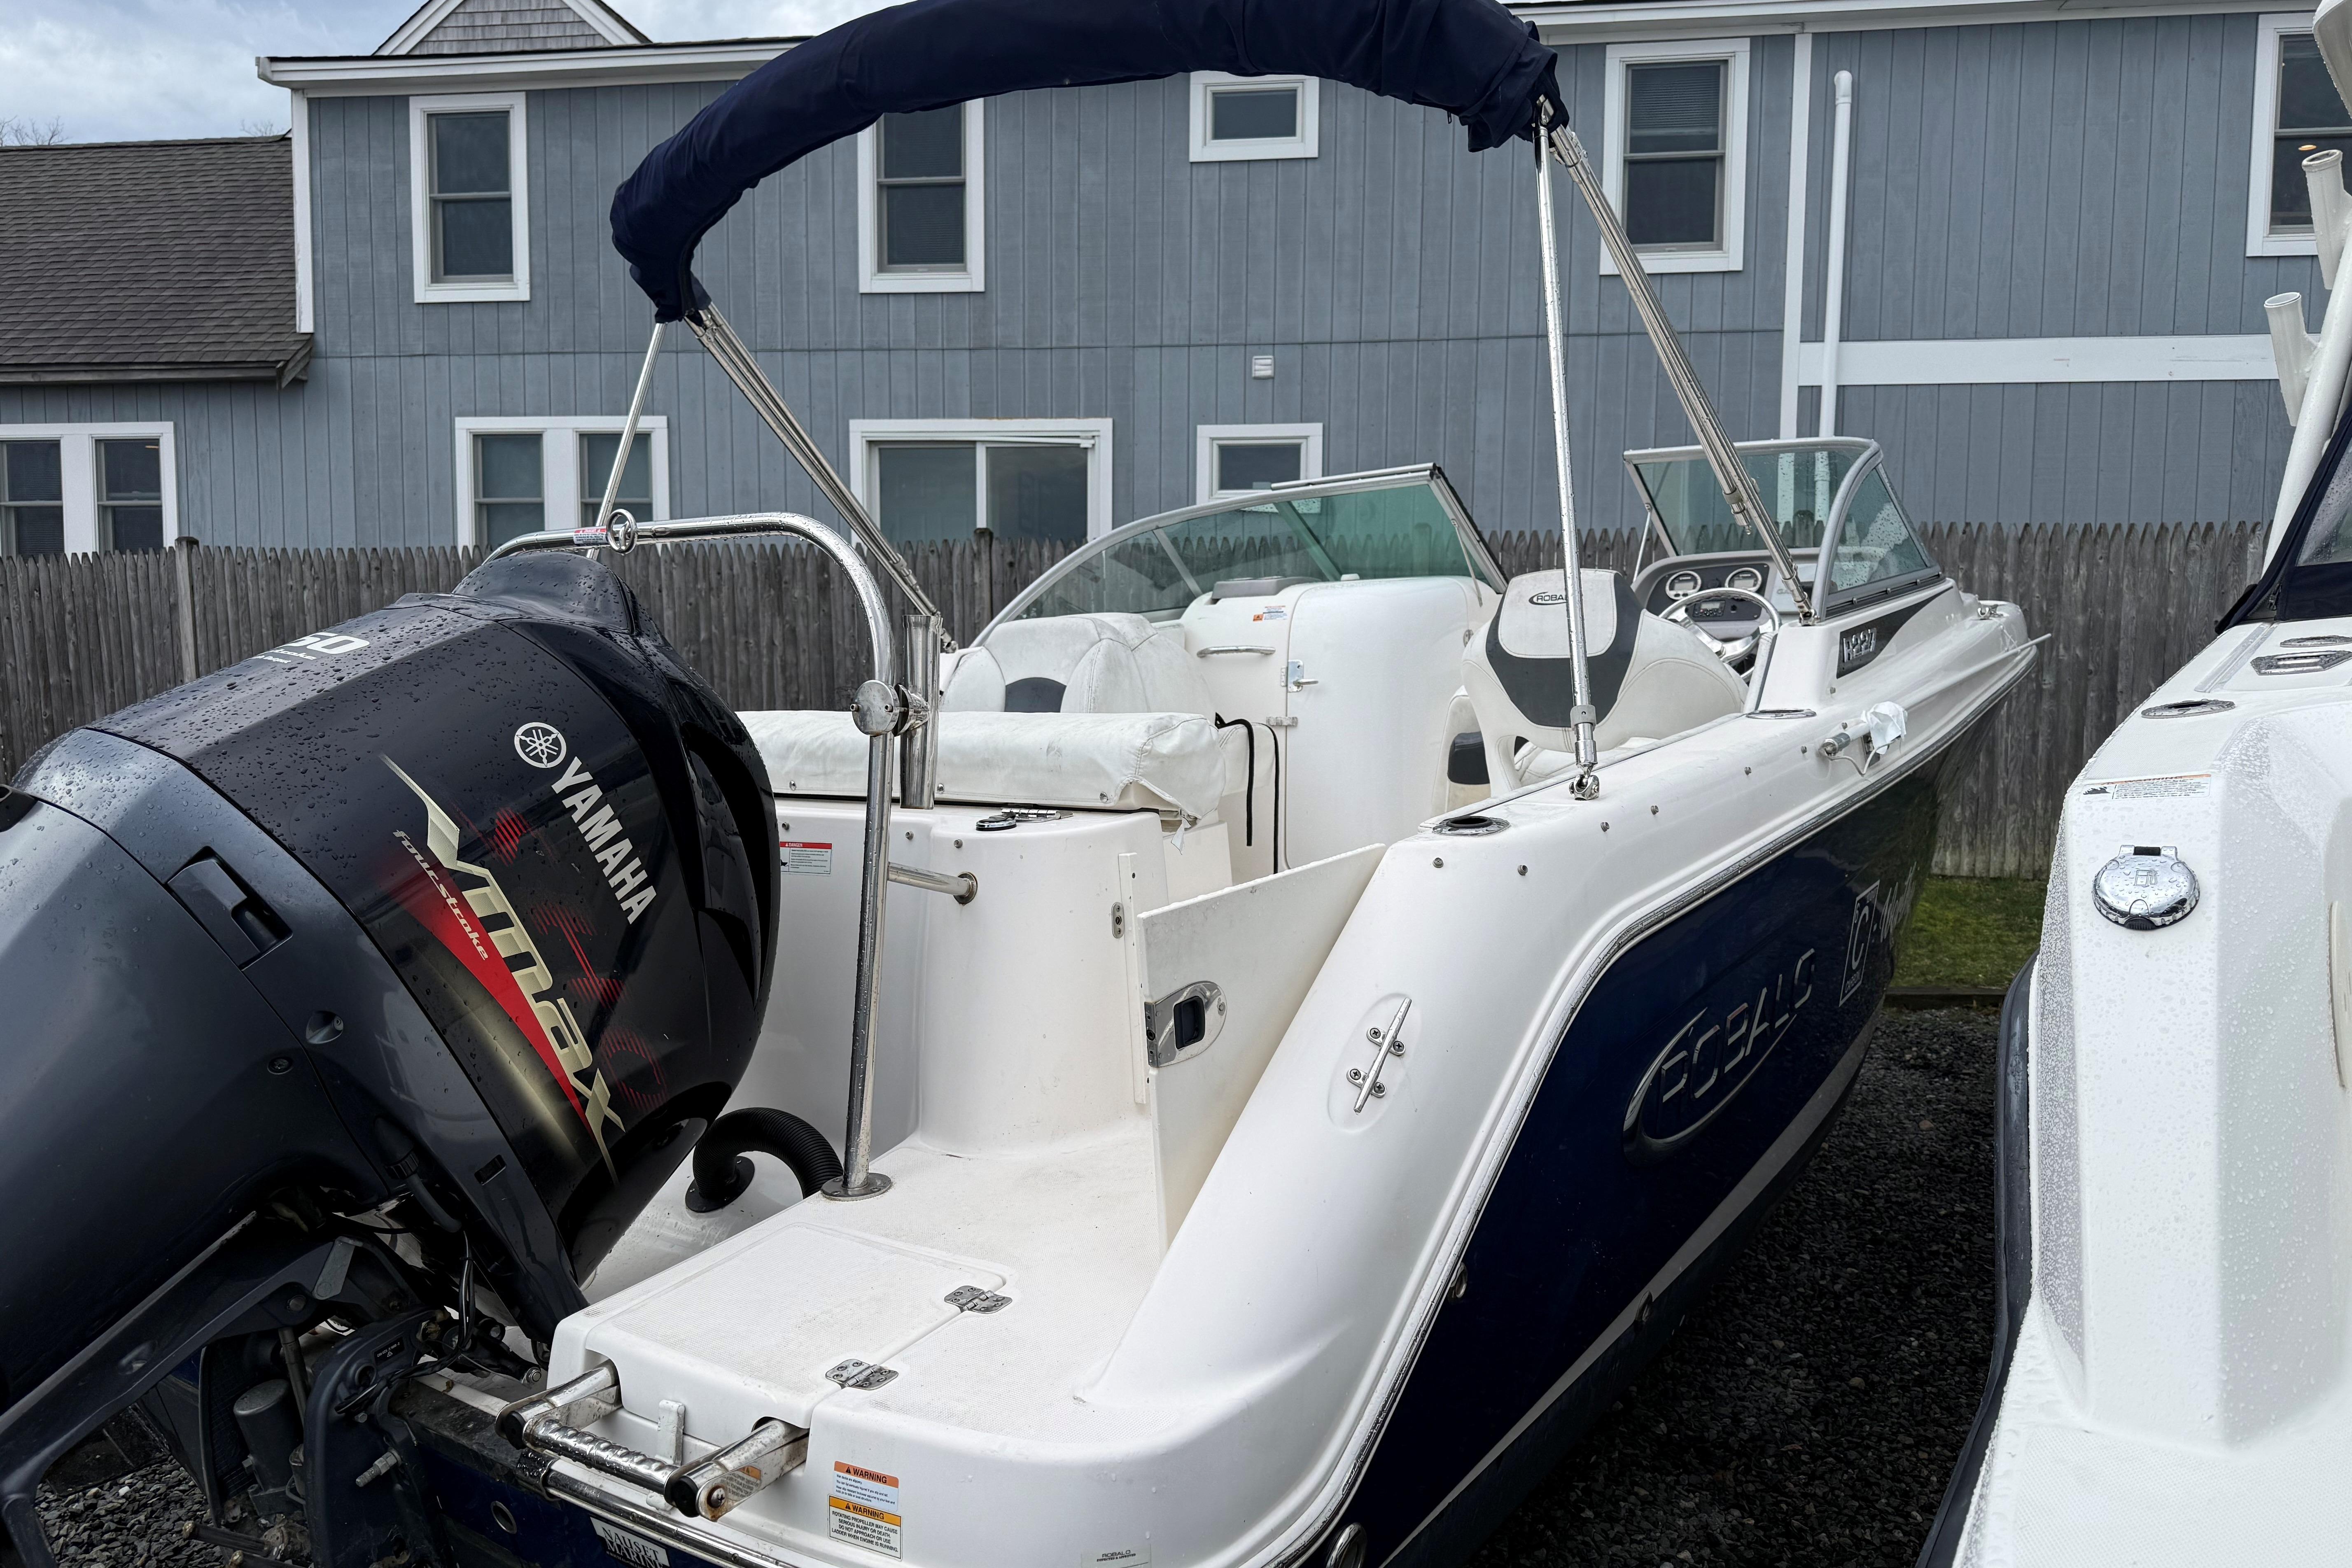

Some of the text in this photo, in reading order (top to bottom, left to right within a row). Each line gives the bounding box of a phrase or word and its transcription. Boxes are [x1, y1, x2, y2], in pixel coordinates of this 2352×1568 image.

[551, 757, 658, 925] YAMAHA
[853, 1468, 887, 1484] WARNING
[832, 1511, 851, 1520] ROTATING
[852, 1517, 874, 1527] PROPELLER
[852, 1505, 884, 1519] WARNING
[839, 1519, 855, 1527] SERIOUS
[856, 1523, 869, 1532] INJURY
[832, 1528, 847, 1536] LADDER
[860, 1537, 875, 1545] ENGINE
[854, 1529, 875, 1540] APPROACH
[602, 1527, 659, 1561] NAUSET
